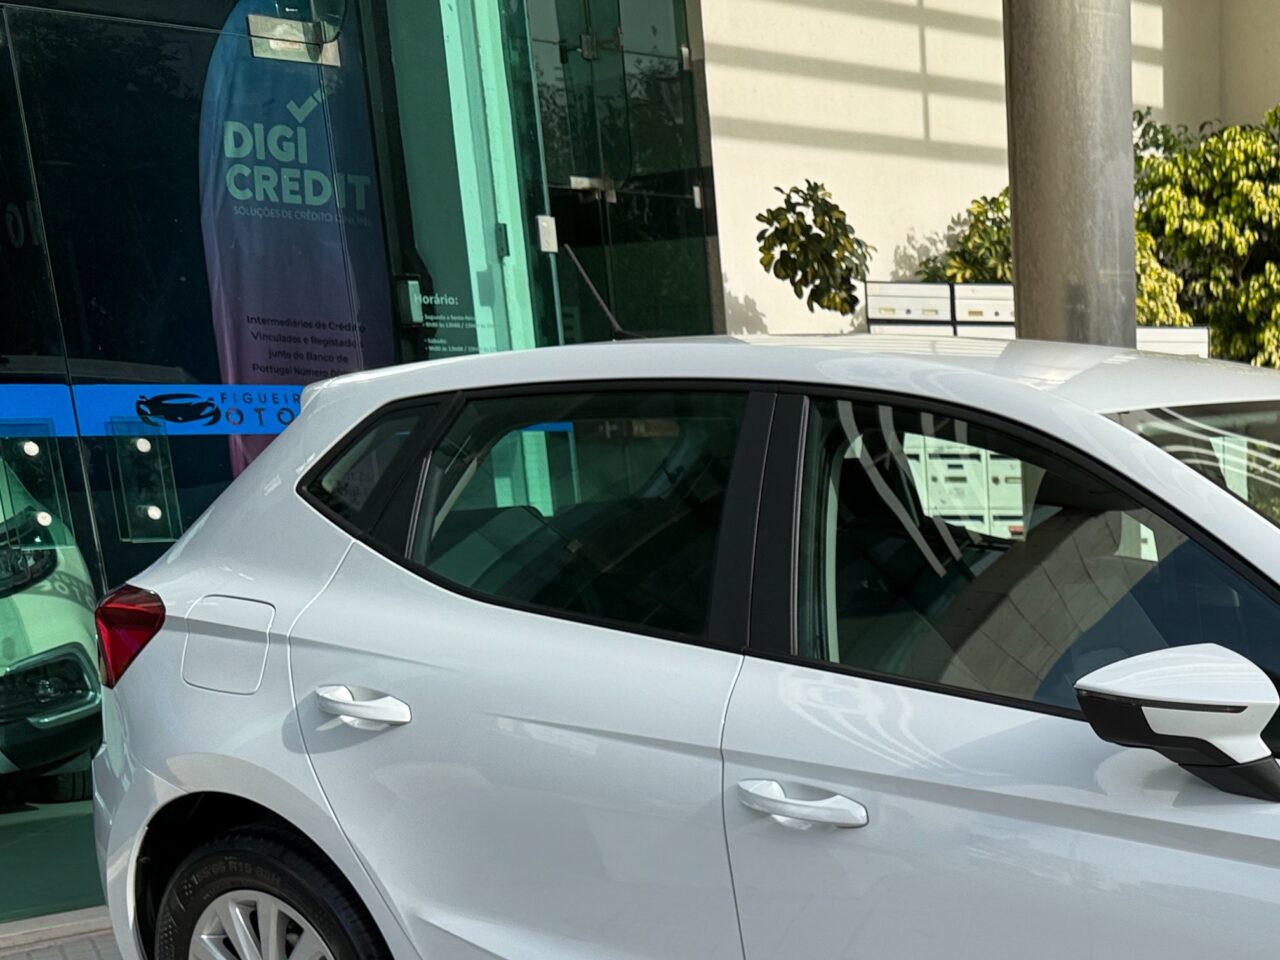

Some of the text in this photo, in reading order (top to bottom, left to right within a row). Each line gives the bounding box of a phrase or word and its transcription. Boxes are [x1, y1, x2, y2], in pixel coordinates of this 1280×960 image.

[223, 120, 308, 164] DIGI
[226, 163, 371, 211] CREDIT
[233, 205, 281, 220] SOLUÇÕES
[282, 210, 292, 220] DE
[294, 208, 333, 223] CRÉDITO
[412, 292, 459, 306] Horário:
[246, 314, 313, 329] Intermediários
[315, 320, 326, 330] de
[251, 331, 364, 350] Vinculados e Registado
[268, 348, 349, 364] junto do Banco de
[252, 363, 293, 376] Portugal
[294, 366, 329, 378] Número
